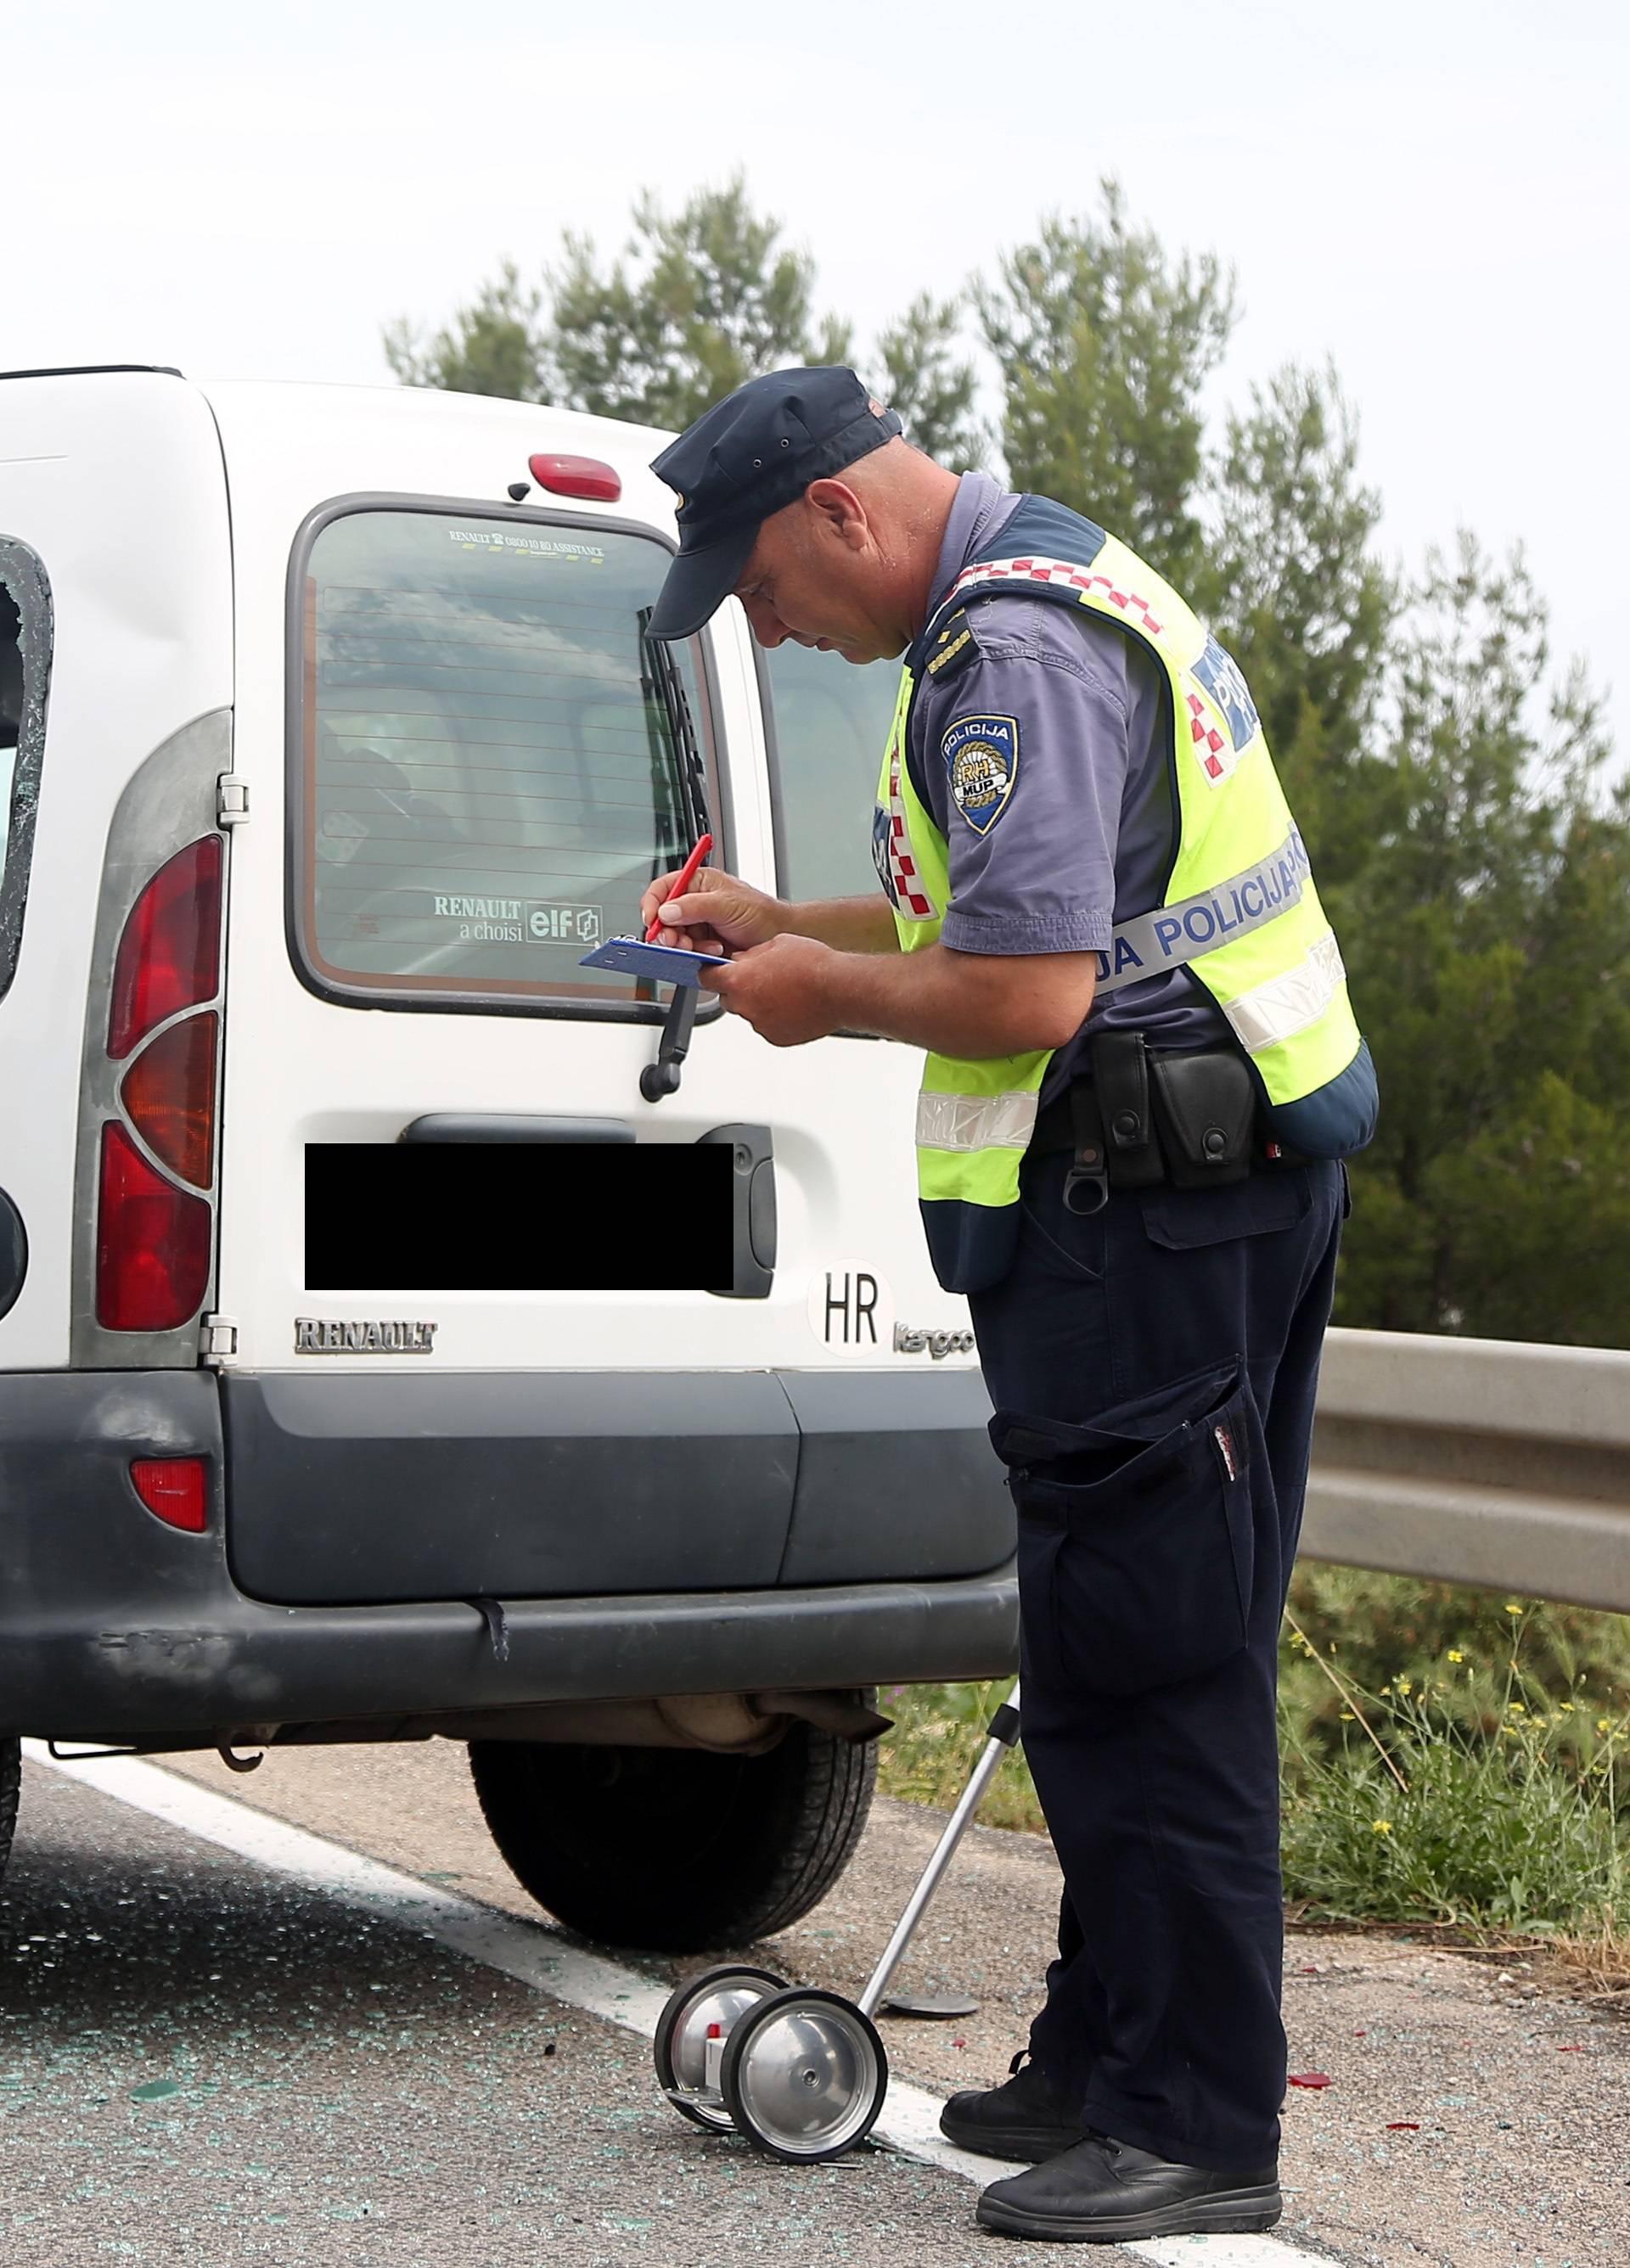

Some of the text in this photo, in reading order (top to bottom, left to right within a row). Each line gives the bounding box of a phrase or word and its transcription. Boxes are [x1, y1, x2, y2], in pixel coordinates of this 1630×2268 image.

[449, 531, 491, 544] RENAULT
[504, 536, 528, 548] 0800
[528, 539, 539, 549] 10
[552, 542, 604, 557] ASSISTANCE
[944, 723, 1009, 756] POLICIJA
[961, 760, 990, 782] RH
[963, 779, 994, 797] MUP
[434, 896, 520, 919] RENAULT
[1154, 859, 1298, 957] POLICIJA
[460, 921, 523, 941] a choisi
[530, 909, 572, 938] elf
[825, 1272, 878, 1344] HR
[295, 1317, 437, 1354] RENAULT
